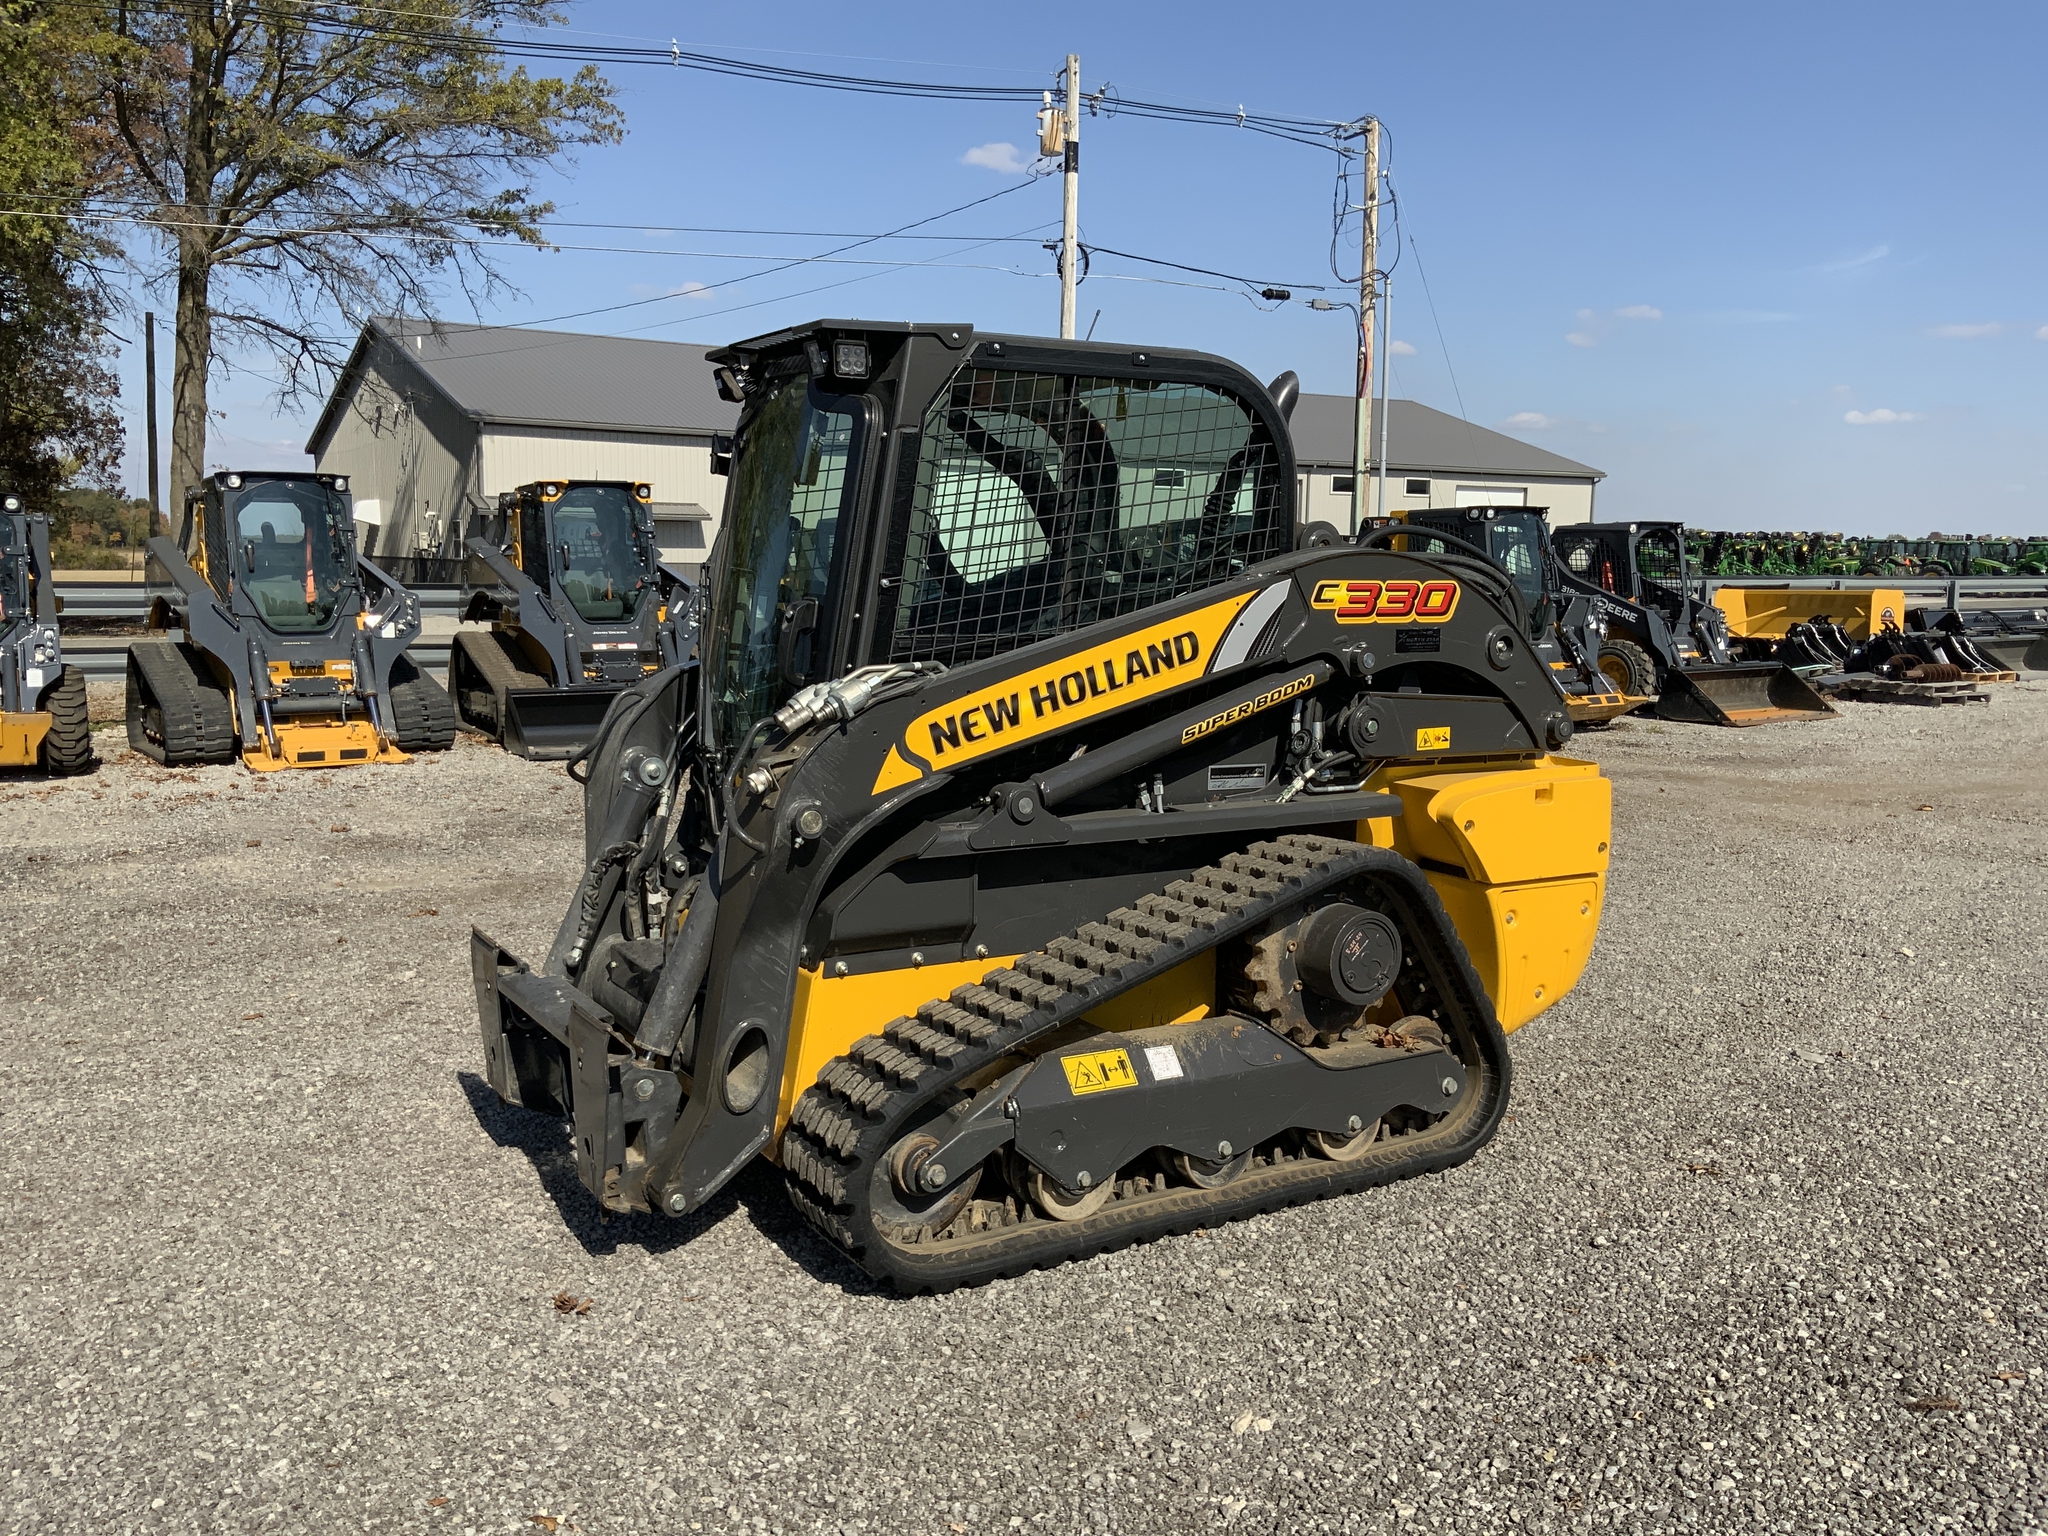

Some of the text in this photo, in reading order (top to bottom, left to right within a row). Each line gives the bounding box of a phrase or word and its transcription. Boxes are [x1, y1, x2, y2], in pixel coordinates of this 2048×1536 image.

[1311, 581, 1459, 621] C330
[928, 630, 1200, 756] NEW HOLLAND
[1181, 674, 1315, 745] SUPER BOOM
